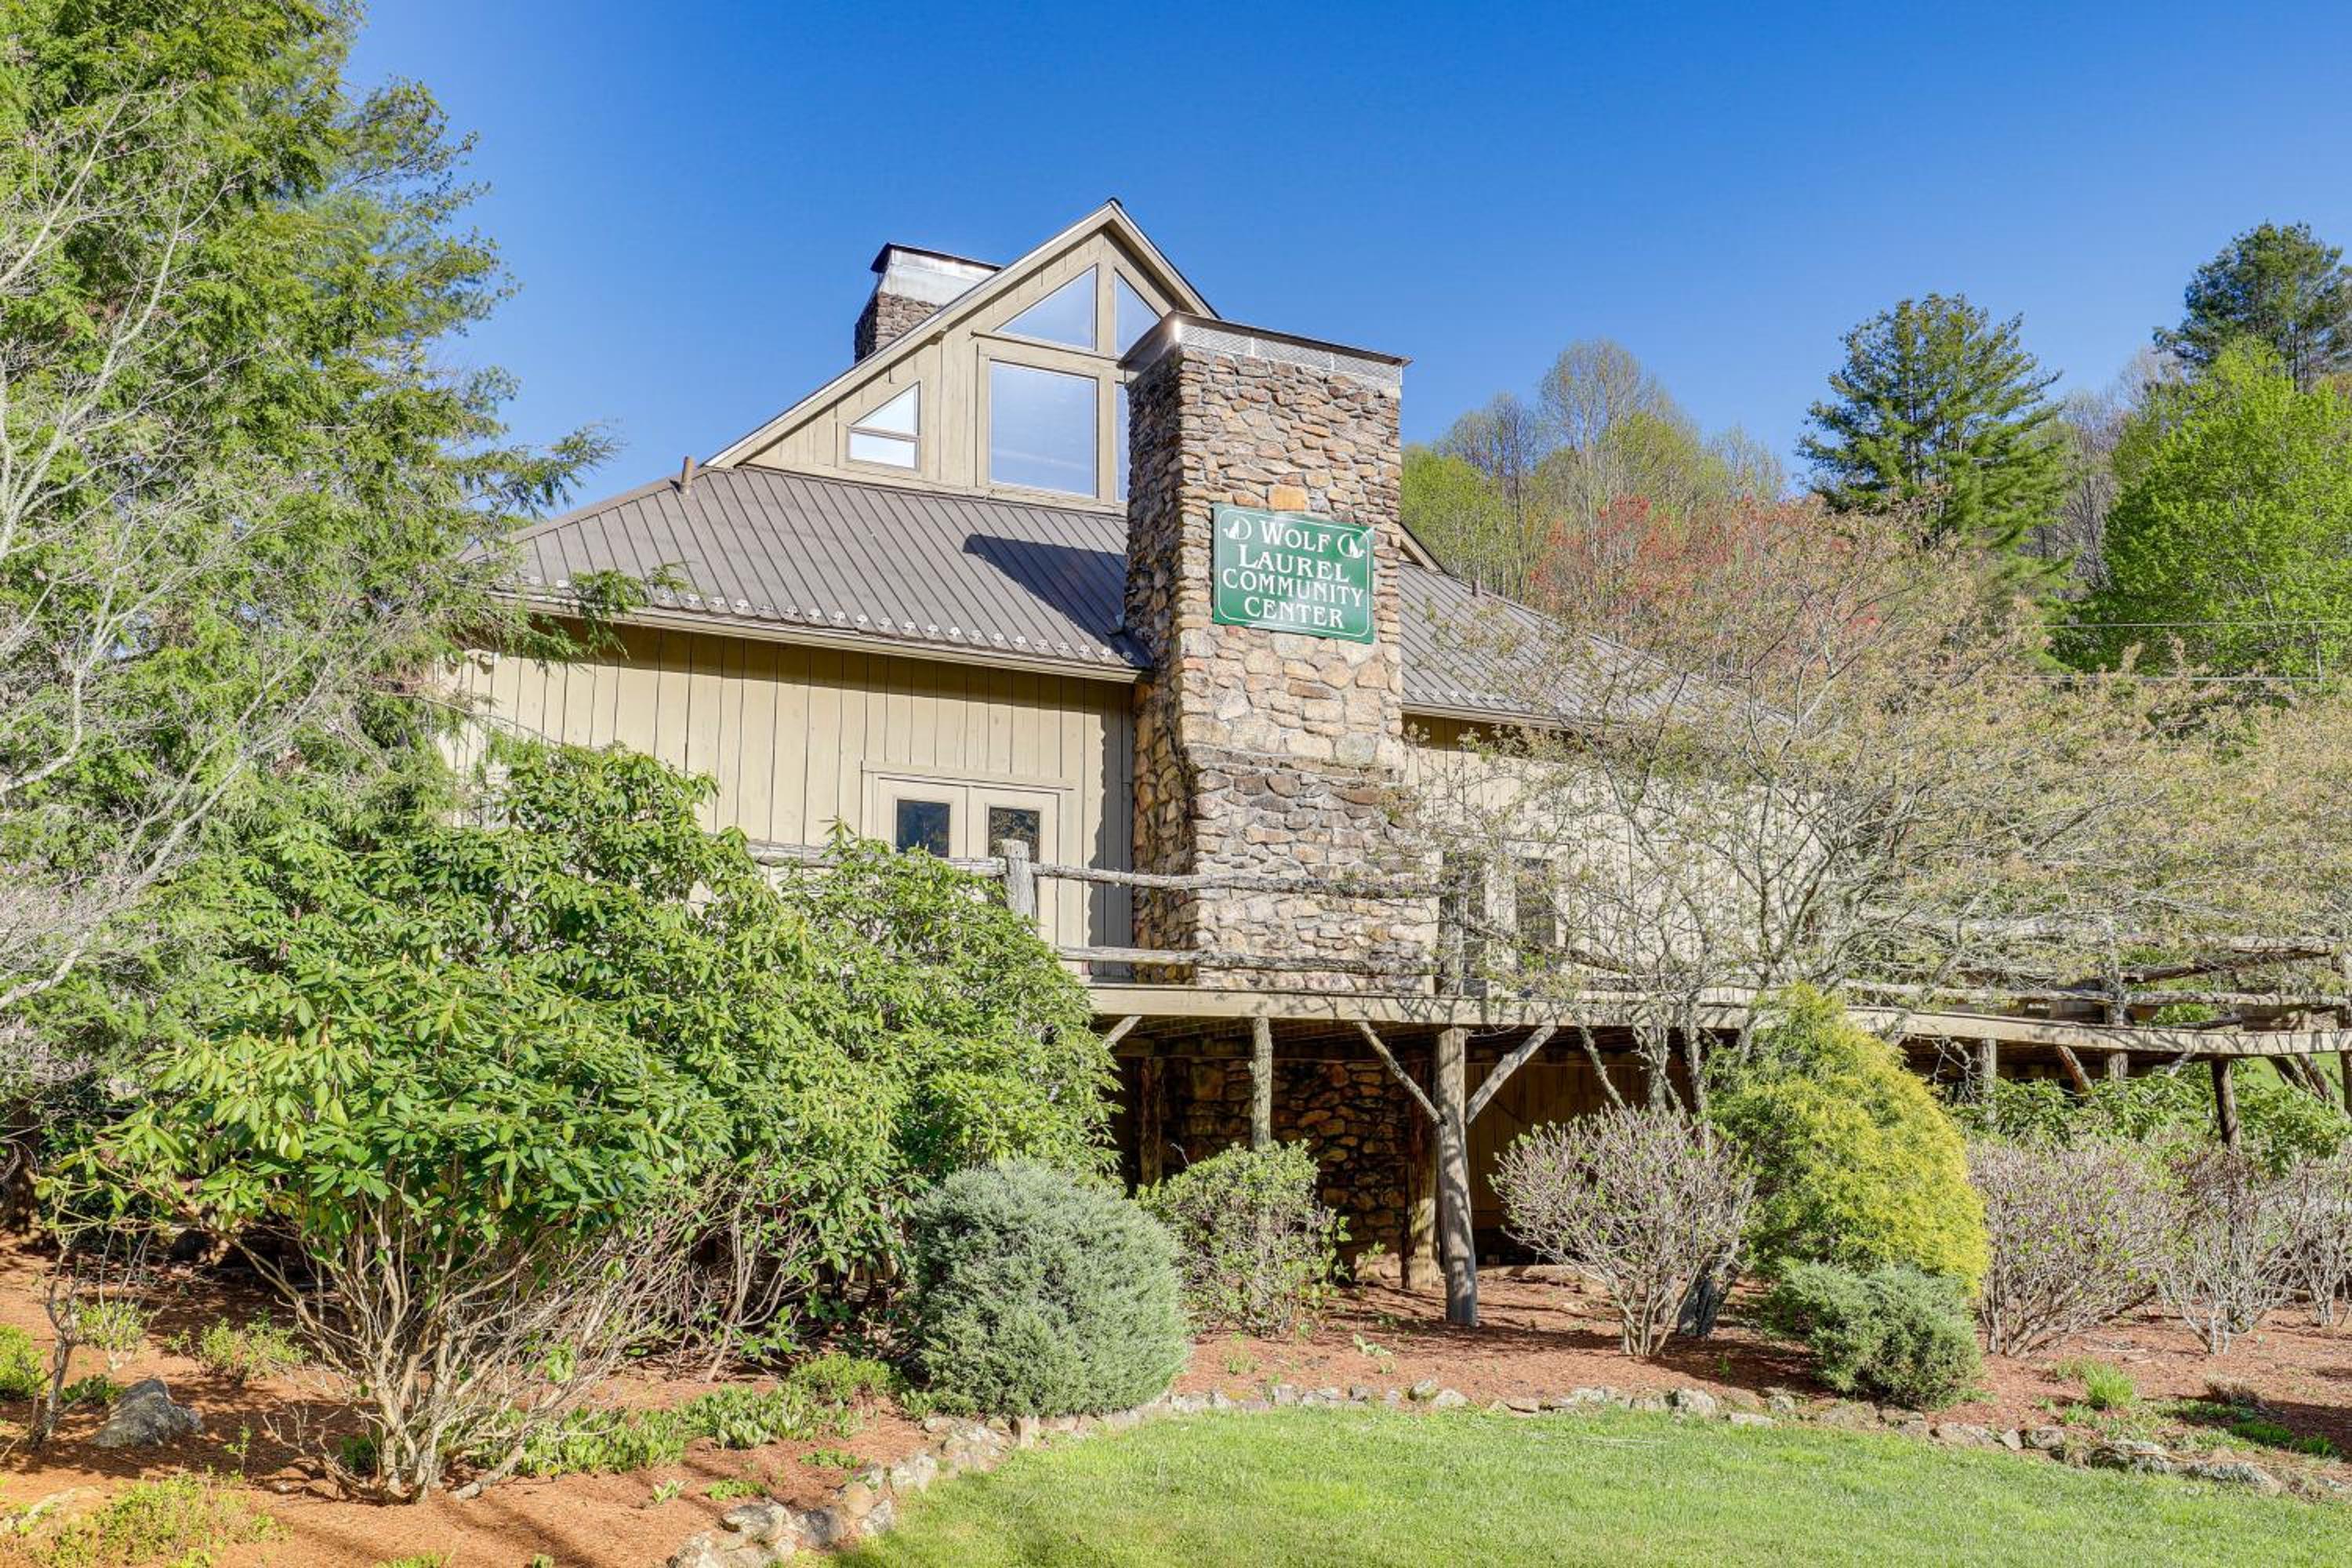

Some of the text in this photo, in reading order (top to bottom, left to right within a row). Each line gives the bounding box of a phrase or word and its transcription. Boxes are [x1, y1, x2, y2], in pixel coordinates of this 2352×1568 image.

[1260, 521, 1330, 553] WOLF
[1239, 544, 1349, 583] LAUREL
[1223, 568, 1364, 607] COMMUNITY
[1244, 597, 1345, 629] CENTER
